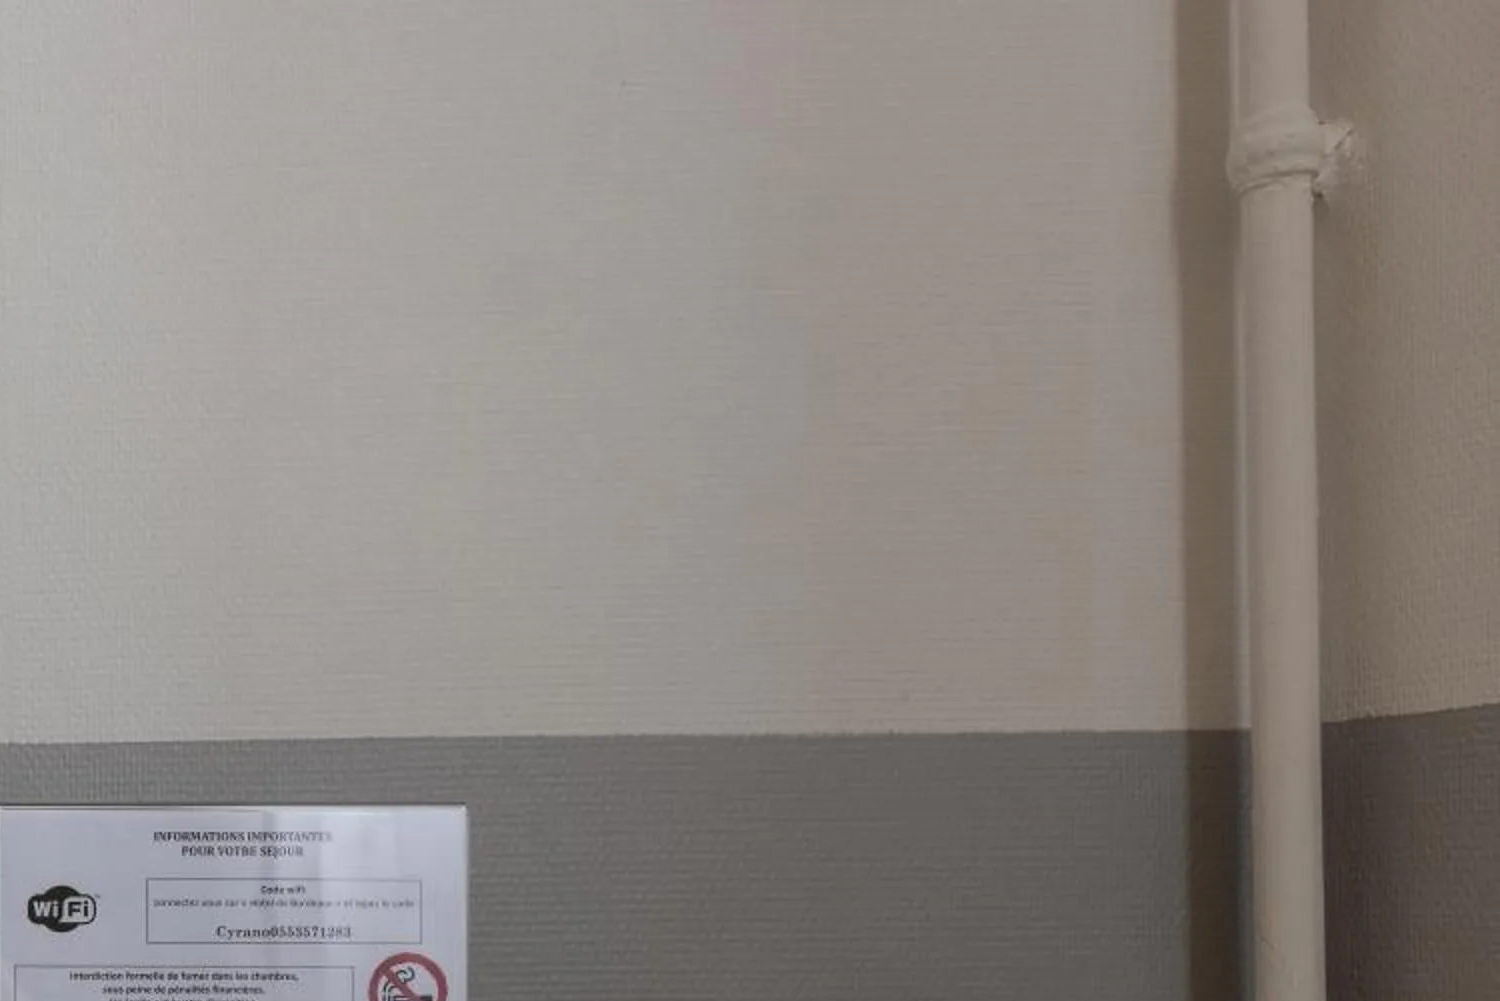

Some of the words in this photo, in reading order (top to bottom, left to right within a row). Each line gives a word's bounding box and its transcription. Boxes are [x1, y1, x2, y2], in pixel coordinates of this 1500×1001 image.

[153, 831, 244, 843] INFORMATIONS
[246, 831, 333, 843] IMPORTANTES
[181, 845, 215, 857] POUR
[217, 845, 257, 857] VOTRE
[68, 971, 124, 982] Interdiction
[126, 971, 165, 982] formelle
[167, 971, 179, 982] de
[211, 971, 233, 982] dans
[235, 971, 248, 982] les
[126, 985, 152, 996] peine
[153, 985, 166, 996] de
